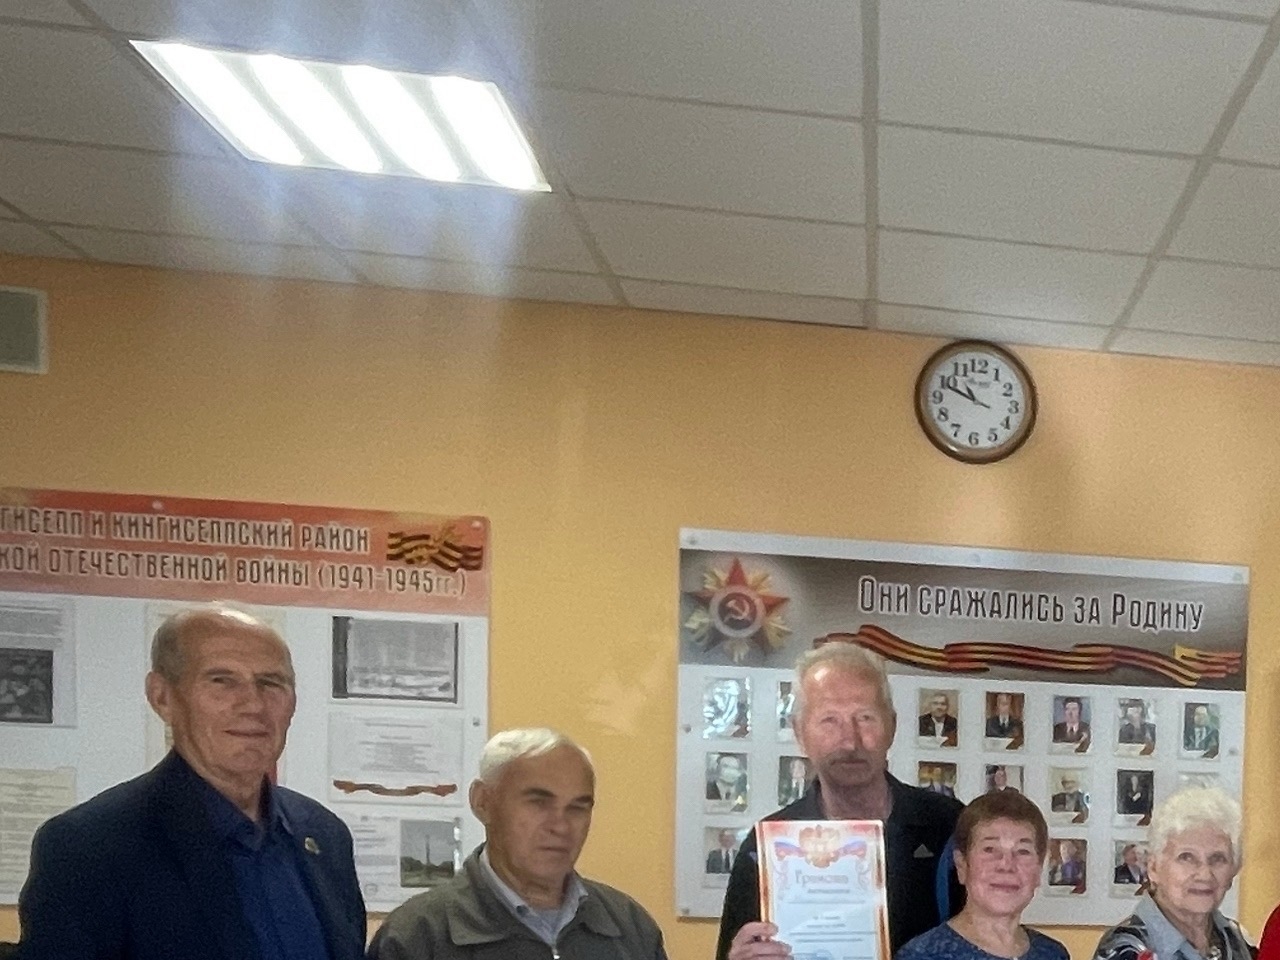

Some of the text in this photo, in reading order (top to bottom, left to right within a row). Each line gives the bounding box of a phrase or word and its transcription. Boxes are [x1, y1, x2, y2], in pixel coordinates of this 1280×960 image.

[953, 362, 969, 377] 11
[970, 358, 988, 374] 12
[940, 375, 958, 389] 10
[994, 368, 1000, 382] 1
[1002, 382, 1013, 397] 2
[932, 390, 944, 404] 9
[937, 406, 949, 422] 8
[1008, 400, 1019, 414] 3
[951, 423, 962, 437] 7
[1000, 416, 1011, 430] 4
[968, 432, 979, 446] 6
[988, 428, 998, 442] 5
[91, 511, 104, 537] И
[112, 512, 293, 549] КИНГИСЕППСКИЙ
[302, 522, 369, 553] РАЙОН
[49, 548, 228, 582] ОТЕЧЕСТВЕННОЙ
[236, 556, 309, 586] ВОЙНЫ
